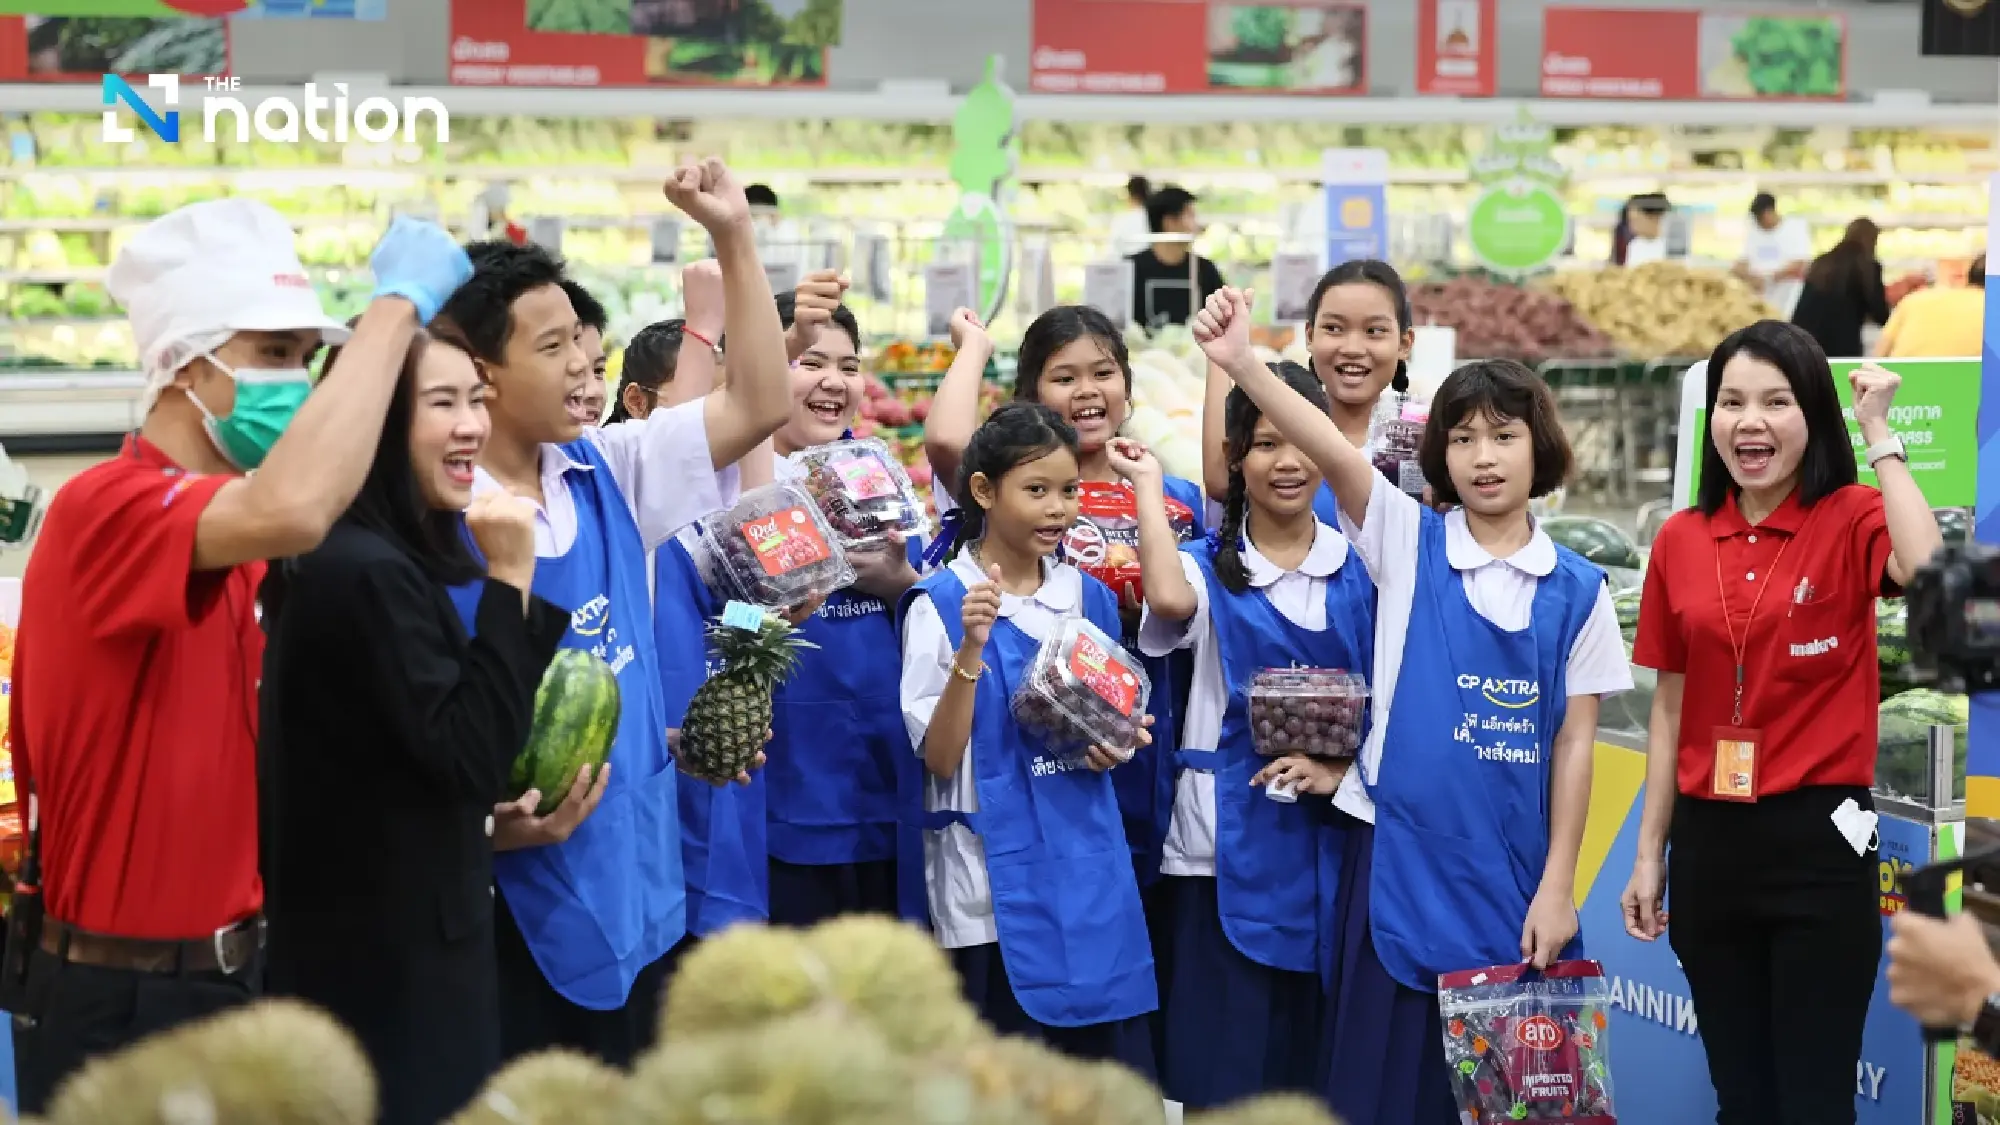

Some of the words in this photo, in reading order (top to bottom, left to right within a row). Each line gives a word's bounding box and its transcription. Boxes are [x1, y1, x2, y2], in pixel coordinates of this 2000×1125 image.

[1790, 635, 1839, 657] makro
[1457, 673, 1480, 689] CP
[1482, 677, 1540, 696] AXTRA
[1531, 1085, 1570, 1098] FRUITS
